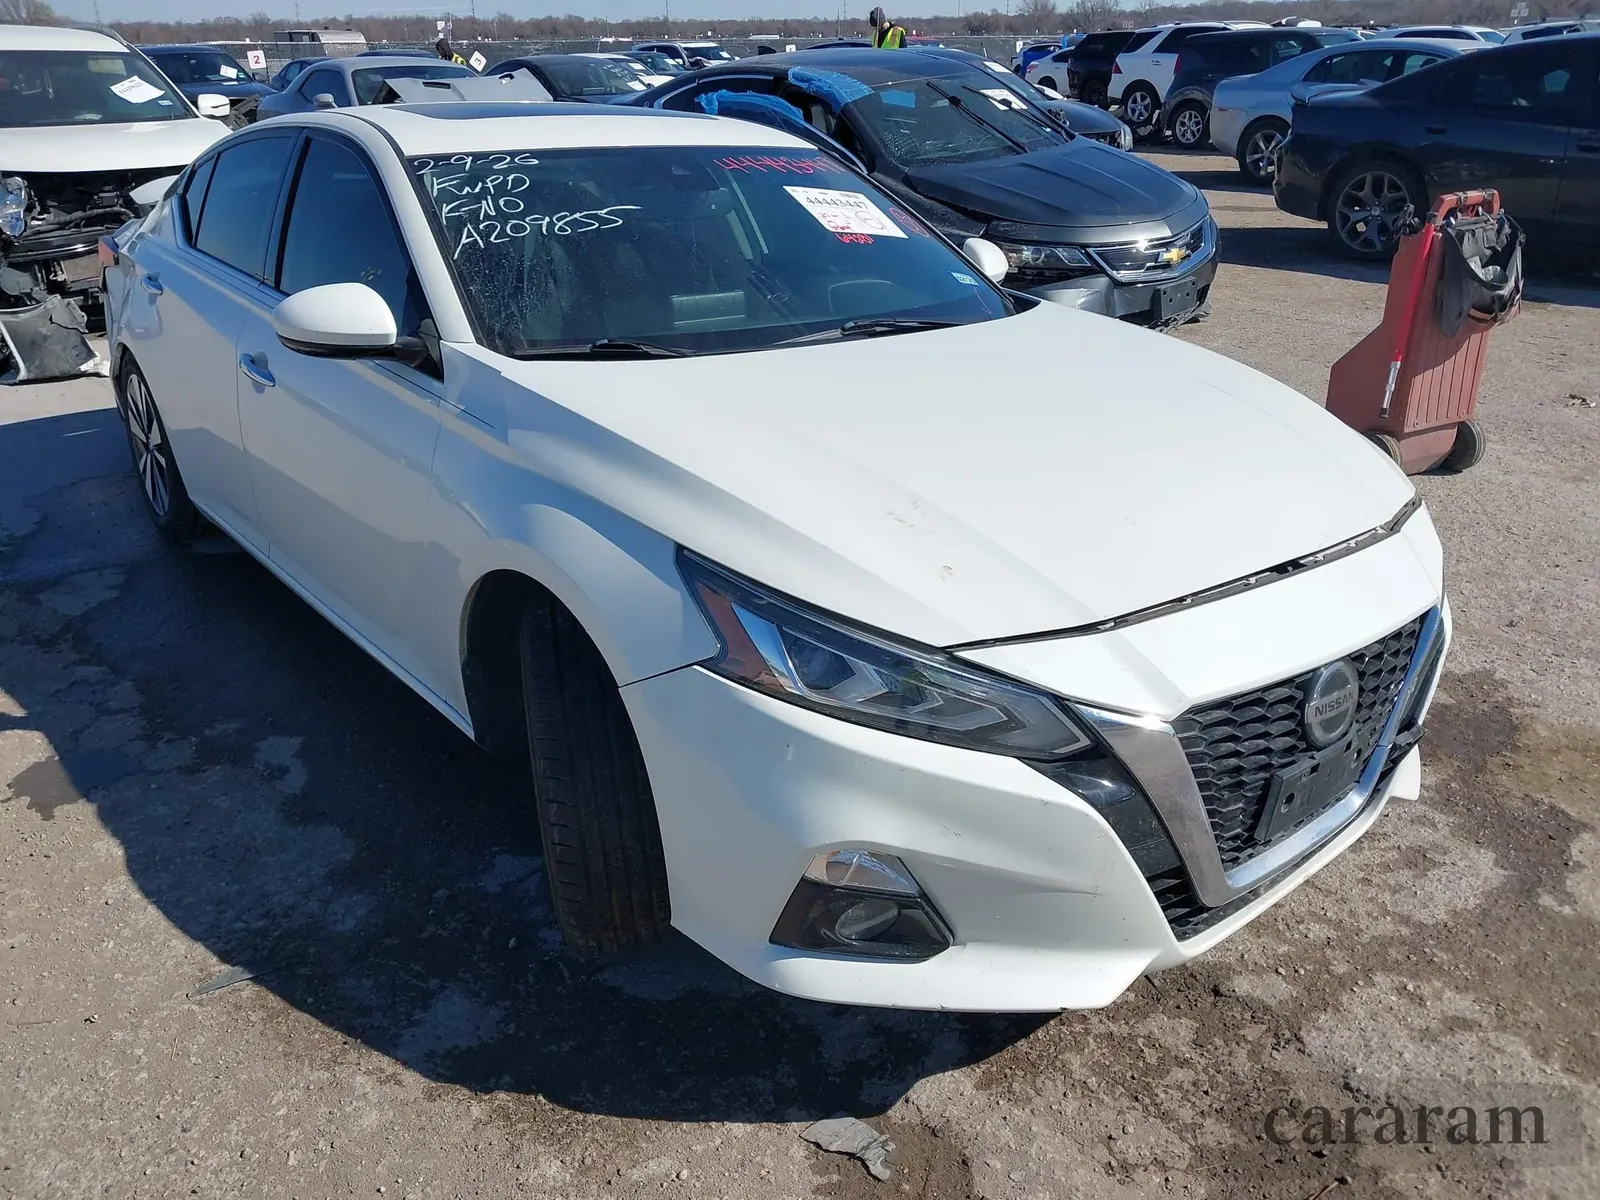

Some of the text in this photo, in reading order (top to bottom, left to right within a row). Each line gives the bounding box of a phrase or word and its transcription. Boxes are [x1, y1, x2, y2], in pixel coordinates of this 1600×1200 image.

[253, 55, 261, 65] 2
[804, 196, 868, 211] 44443447
[453, 205, 643, 261] A209855
[1314, 690, 1353, 717] NISSAN
